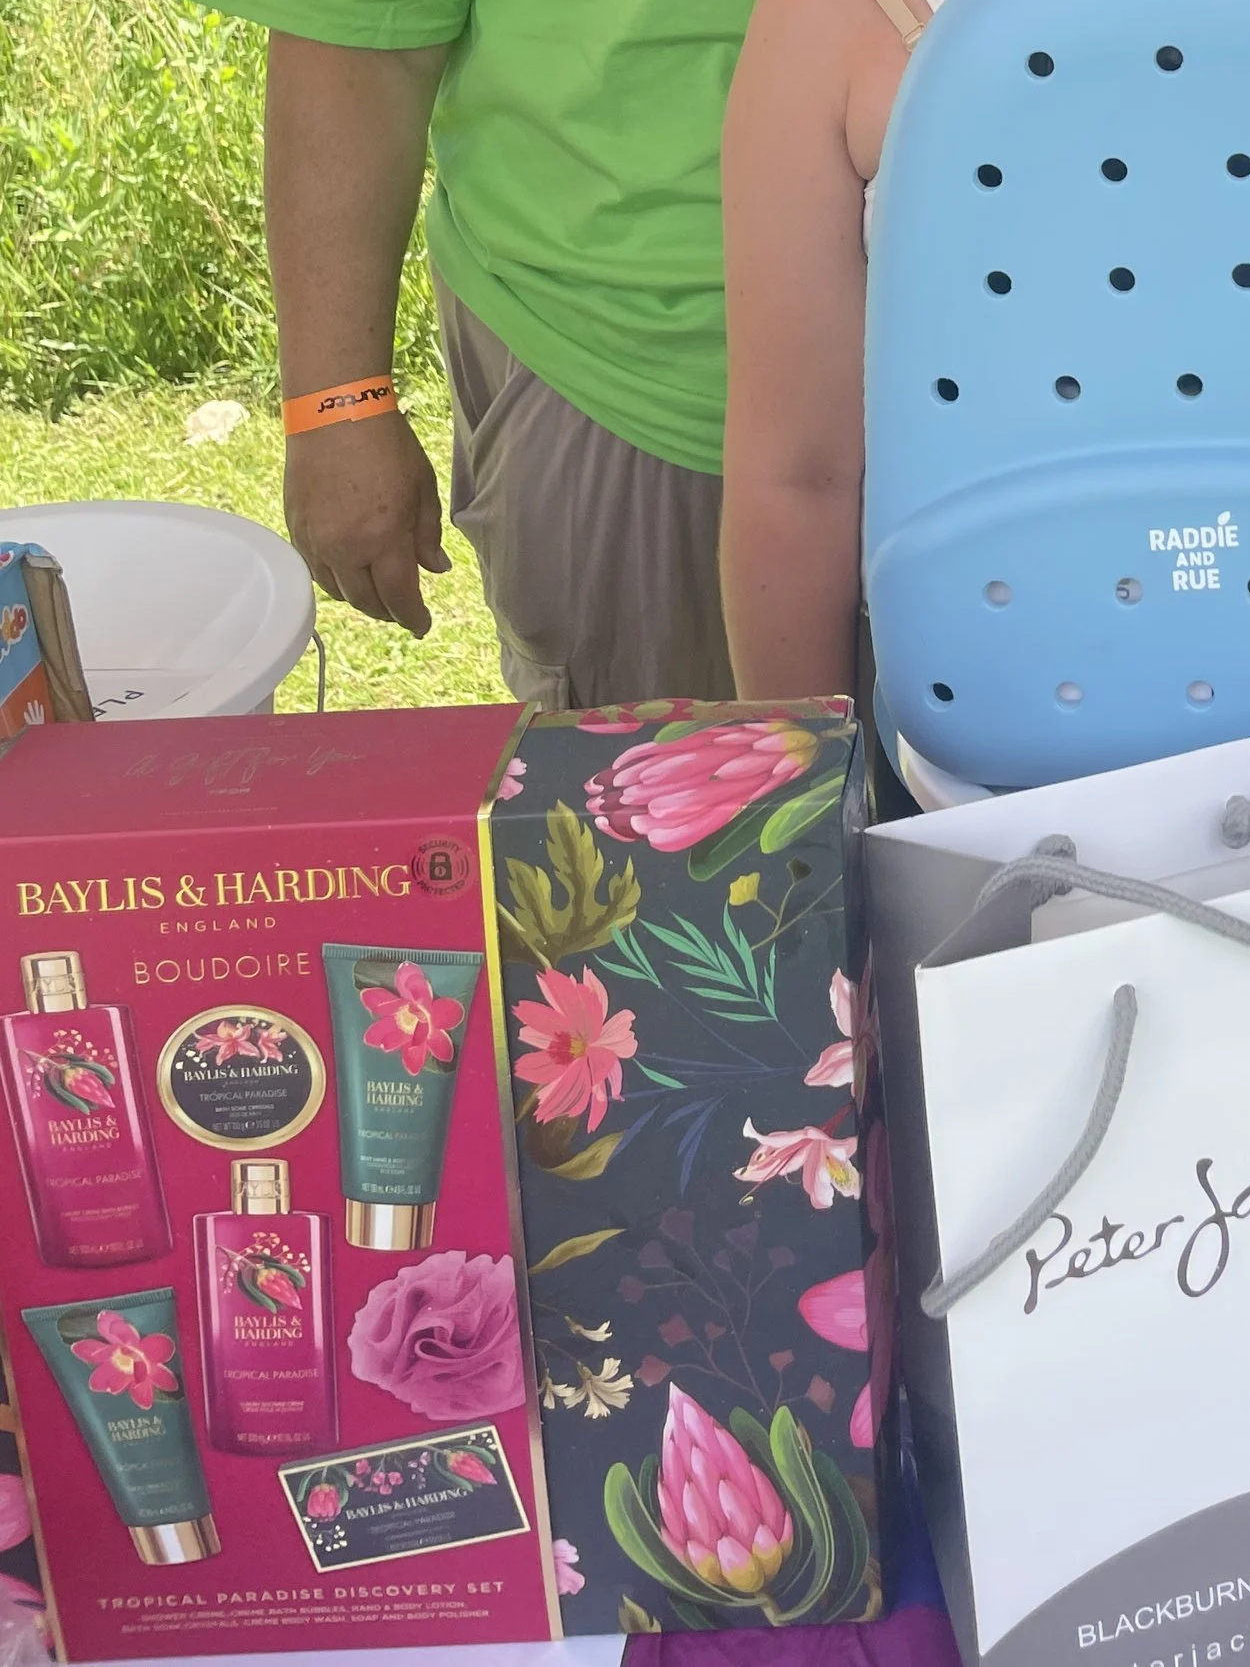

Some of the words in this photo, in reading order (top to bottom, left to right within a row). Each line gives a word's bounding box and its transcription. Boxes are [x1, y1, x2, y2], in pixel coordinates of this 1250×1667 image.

[317, 386, 391, 413] volunteer
[1149, 524, 1239, 551] RADDIE
[1176, 551, 1215, 567] AND
[1172, 568, 1221, 591] RUE
[92, 690, 145, 718] PLA
[17, 876, 165, 916] BAYLIS
[175, 874, 208, 908] &
[213, 864, 412, 907] HARDING
[160, 916, 276, 934] ENGLAND
[134, 951, 311, 985] BOUDOIRE
[184, 1068, 227, 1082] BAYLIS
[229, 1068, 238, 1078] &
[240, 1064, 299, 1079] HARDING
[245, 1088, 288, 1100] PARADISE
[367, 1081, 411, 1094] BAYLIS
[414, 1083, 424, 1094] &
[367, 1093, 424, 1107] HARDING
[48, 1116, 102, 1133] BAYLIS
[105, 1114, 117, 1127] &
[51, 1127, 120, 1145] HARDING
[1023, 1213, 1185, 1315] Peter
[234, 1316, 287, 1328] BAYLIS
[291, 1315, 301, 1326] &
[234, 1328, 303, 1340] HARDING
[223, 1369, 270, 1380] TROPICAL
[272, 1368, 320, 1379] PARADISE
[107, 1417, 151, 1432] BAYLIS
[346, 1502, 392, 1520] BAYLIS
[394, 1500, 404, 1510] &
[405, 1487, 468, 1509] HARDING
[97, 1593, 208, 1610] TROPICAL
[217, 1587, 324, 1604] PARADISE
[334, 1584, 456, 1599] DISCOVERY
[467, 1581, 504, 1594] SET
[351, 1604, 381, 1612] HAND
[393, 1603, 422, 1611] BODY
[382, 1613, 403, 1621] AND
[407, 1612, 436, 1620] BODY
[439, 1610, 489, 1619] POLISHER
